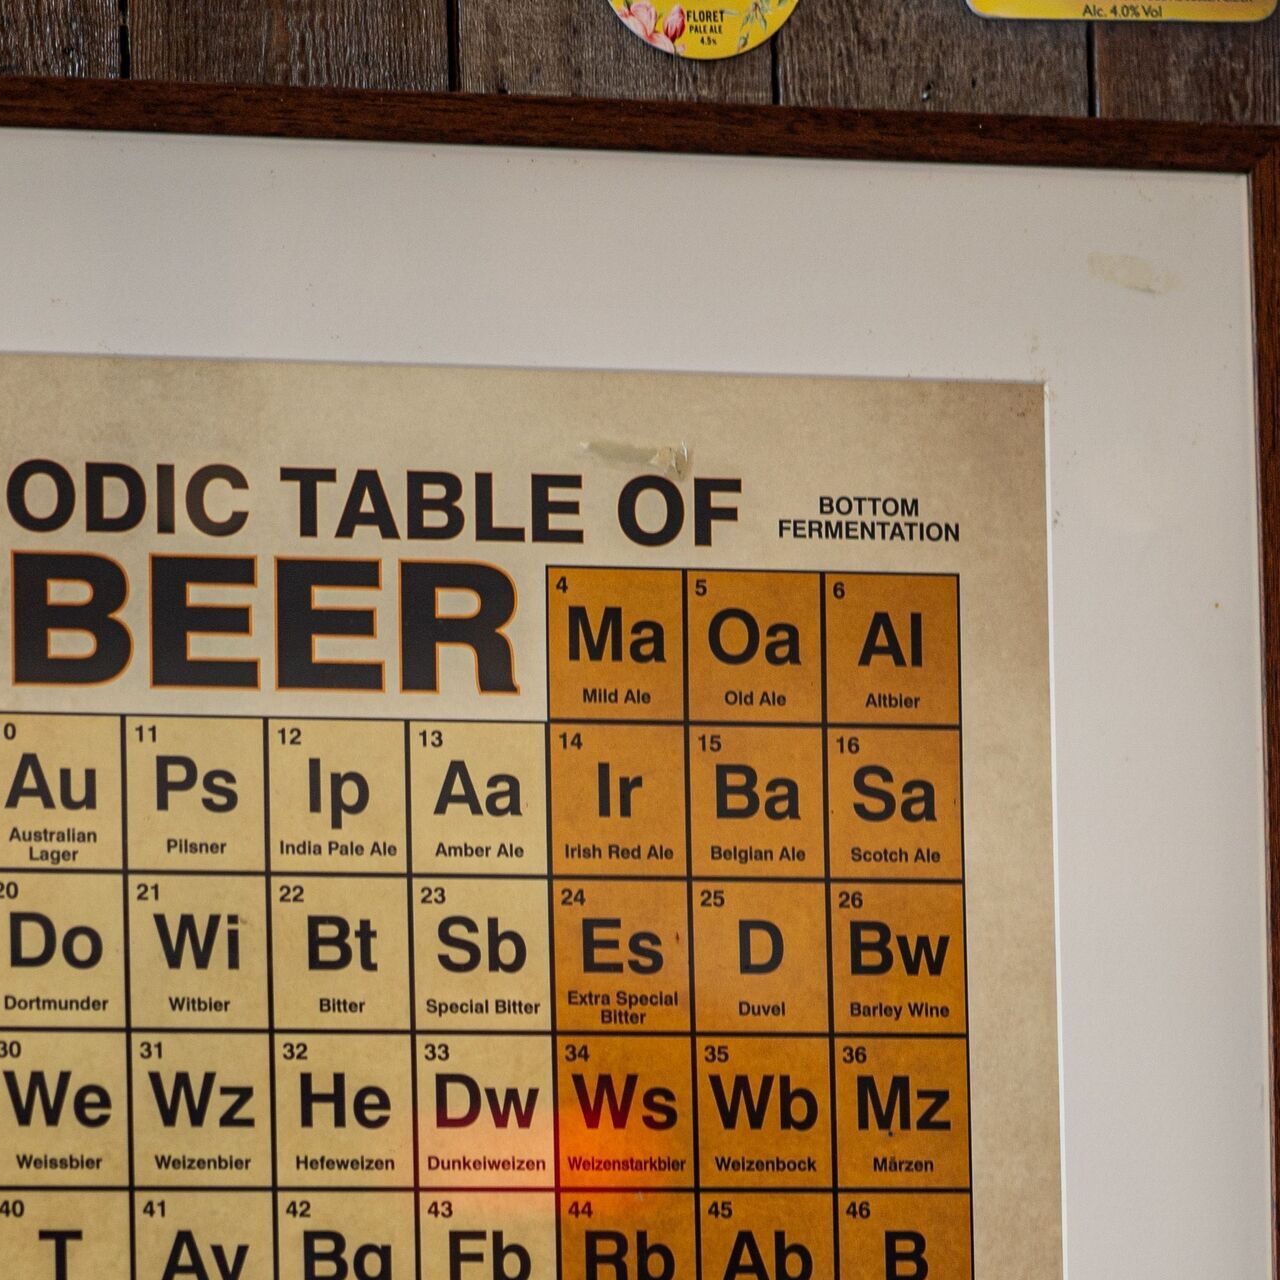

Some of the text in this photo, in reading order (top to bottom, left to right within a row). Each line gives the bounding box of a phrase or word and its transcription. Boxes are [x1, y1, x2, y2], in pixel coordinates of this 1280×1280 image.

[687, 10, 724, 22] FLORET
[689, 25, 722, 34] PALE ALE
[279, 467, 584, 544] TABLE
[617, 474, 742, 547] OF
[778, 519, 959, 542] FERMENTATION
[820, 496, 918, 516] BOTTOM
[10, 549, 521, 696] BEER
[569, 606, 666, 664] Ma
[708, 608, 801, 666] Oa
[858, 612, 922, 667] Al
[583, 688, 651, 704] Mild Ale
[725, 690, 786, 706] Old Ale
[866, 693, 920, 708] Altbier
[5, 753, 96, 810] Au
[156, 755, 238, 813] Ps
[309, 758, 370, 829] Ip
[434, 760, 522, 817] Aa
[598, 762, 642, 818] Ir
[716, 764, 800, 821] Ba
[853, 765, 937, 822] Sa
